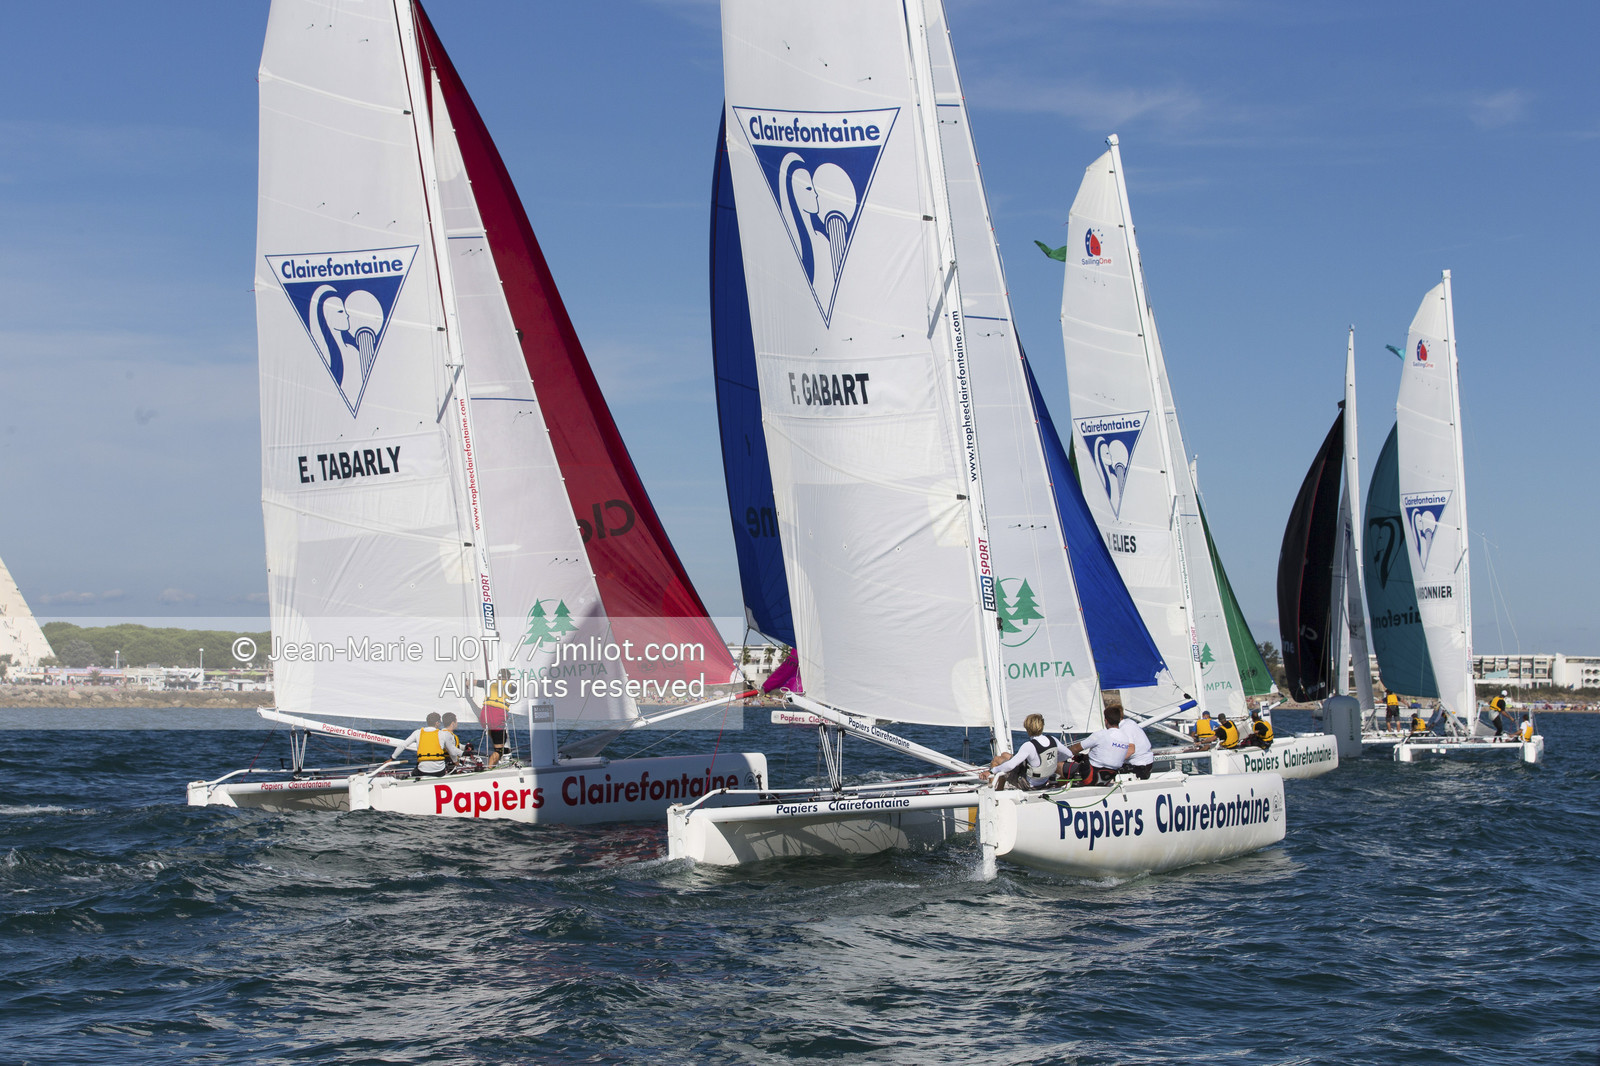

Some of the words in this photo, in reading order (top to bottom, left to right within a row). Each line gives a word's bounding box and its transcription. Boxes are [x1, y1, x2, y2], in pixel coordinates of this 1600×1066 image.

[749, 115, 881, 143] Clairefontaine
[281, 255, 404, 279] Clairefontaine
[1081, 257, 1112, 266] SailingOne
[788, 372, 800, 405] F.
[802, 372, 869, 406] GABART
[953, 309, 977, 482] www.tropheeclairefontaine.com
[1080, 417, 1141, 434] Clairefontaine
[298, 456, 315, 484] E.
[317, 446, 401, 481] TABARLY
[459, 398, 480, 531] www.tropheeclairefontaine.com
[1404, 494, 1446, 506] Clairefontaine
[1112, 533, 1137, 553] ELIES
[780, 714, 805, 724] Papiers
[322, 723, 346, 735] Papiers
[347, 729, 391, 744] Clairefontaine
[848, 717, 870, 733] Papiers
[870, 726, 910, 749] Clairefontaine
[1243, 750, 1280, 773] Papiers
[1283, 746, 1332, 768] Clairefontaine
[260, 782, 284, 792] Papiers
[288, 780, 332, 790] Clairefontaine
[434, 781, 544, 818] Papiers
[561, 767, 739, 807] Clairefontaine
[776, 803, 818, 816] Papiers
[828, 798, 910, 811] Clairefontaine
[1056, 800, 1144, 851] Papiers
[1155, 788, 1270, 834] Clairefontaine
